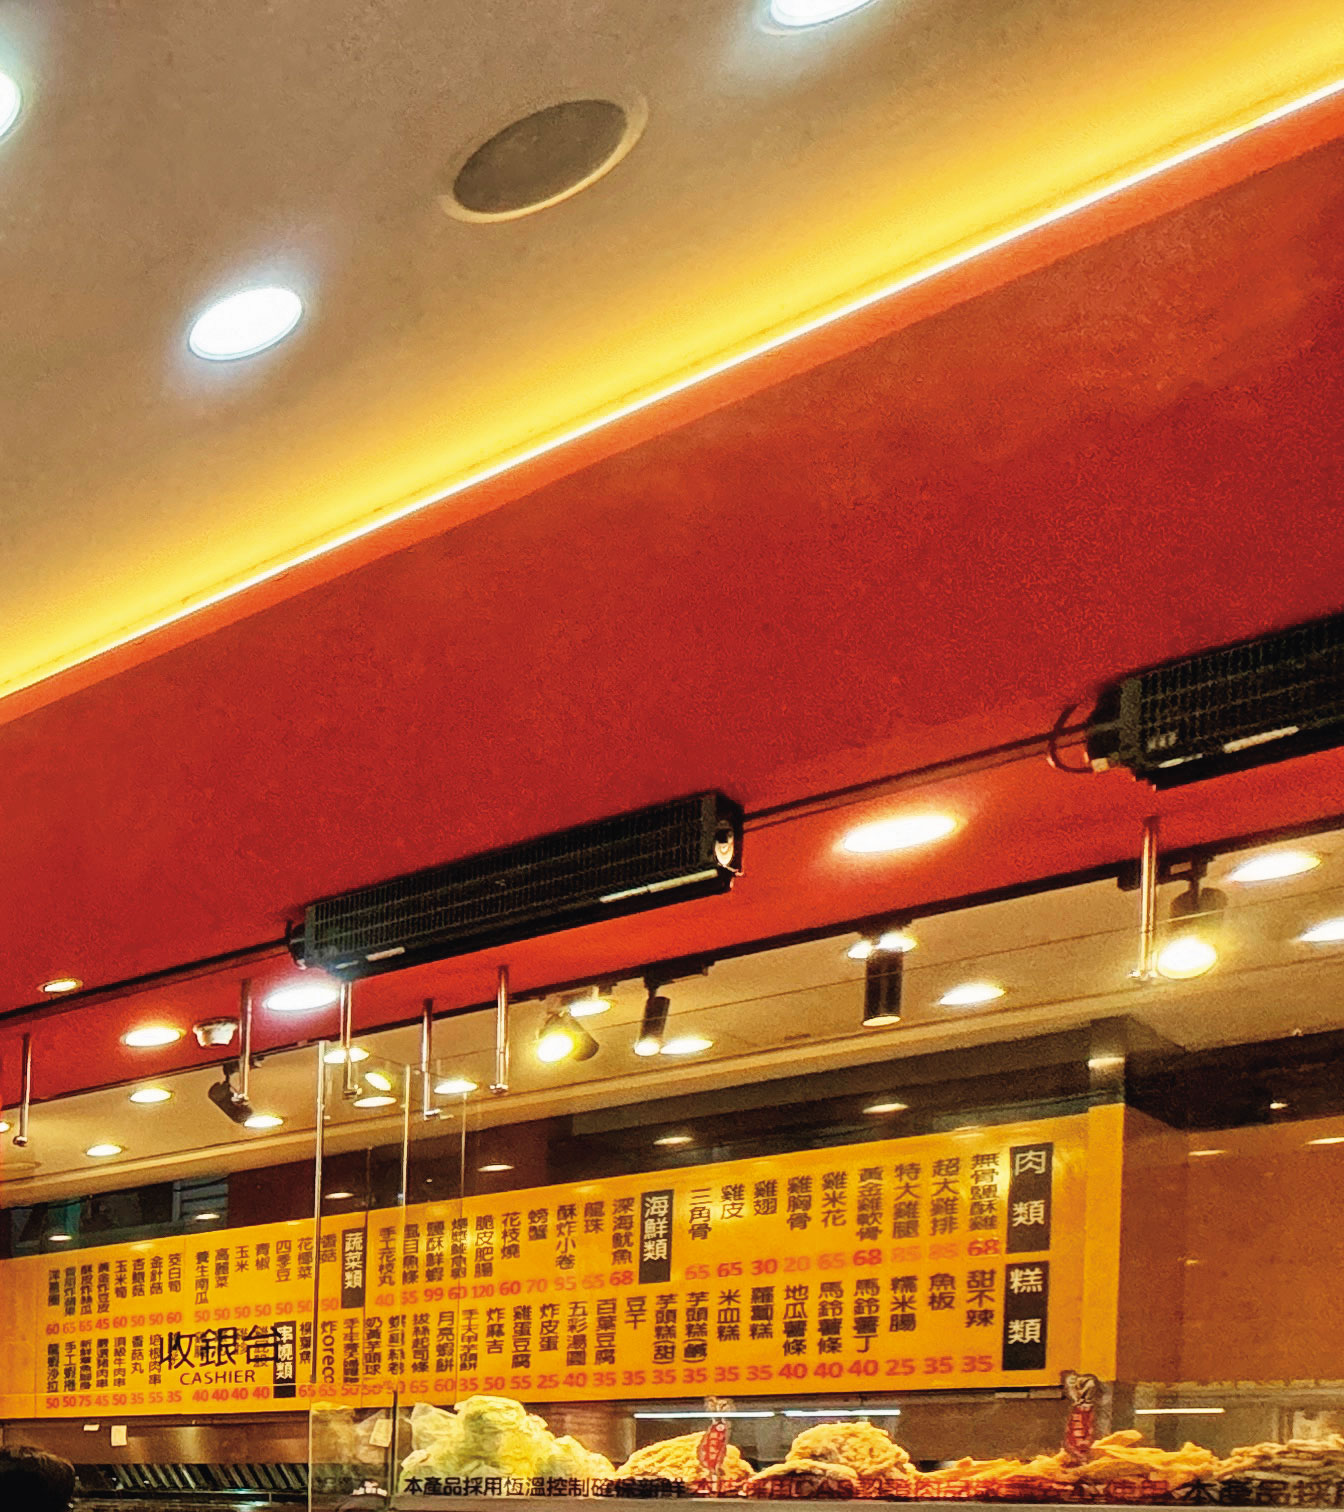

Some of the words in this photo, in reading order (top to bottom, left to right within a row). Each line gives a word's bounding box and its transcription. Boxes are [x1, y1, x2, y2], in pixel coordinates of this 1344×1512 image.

[753, 1179, 778, 1216] 雞翅
[929, 1157, 960, 1236] 超大雞排
[1012, 1150, 1047, 1227] 肉類
[720, 1183, 745, 1220] 雞皮
[786, 1175, 813, 1231] 雞胸骨
[821, 1171, 847, 1228] 雞米花
[856, 1166, 884, 1241] 黃金雞軟骨
[892, 1162, 921, 1239] 特大雞腿
[688, 1187, 712, 1241] 三角骨
[611, 1197, 636, 1266] 深海魷魚
[643, 1195, 669, 1262] 海鮮類
[967, 1239, 1000, 1256] 68
[234, 1245, 250, 1273] 玉米
[275, 1240, 292, 1283] 四季豆
[344, 1232, 364, 1290] 蔬菜類
[783, 1255, 811, 1273] 20
[853, 1248, 882, 1266] 68
[684, 1264, 711, 1280] 65
[716, 1262, 743, 1278] 65
[751, 1258, 778, 1275] 30
[526, 1278, 548, 1294] 70
[609, 1270, 633, 1286] 68
[424, 1287, 444, 1302] 99
[471, 1284, 495, 1299] 120
[499, 1280, 522, 1296] 60
[928, 1272, 956, 1311] 魚板
[889, 1275, 918, 1332] 糯米腸
[965, 1268, 996, 1328] 甜不辣
[1008, 1267, 1043, 1344] 糕類
[275, 1302, 294, 1315] 50
[624, 1296, 647, 1330] 豆干
[717, 1289, 741, 1342] 米血糕
[817, 1281, 843, 1354] 馬鈴薯條
[853, 1278, 880, 1353] 馬鈴薯丁
[539, 1303, 560, 1352] 炸皮蛋
[783, 1283, 809, 1356] 地瓜薯條
[486, 1307, 506, 1354] 炸麻吉
[511, 1305, 532, 1369] 雞蛋豆腐
[160, 1325, 282, 1370] 收銀台
[435, 1311, 455, 1373] 月亮蝦餅
[746, 1365, 773, 1381] 35
[778, 1363, 808, 1379] 40
[814, 1362, 843, 1378] 40
[848, 1359, 879, 1377] 40
[885, 1358, 915, 1376] 25
[923, 1356, 953, 1374] 35
[962, 1355, 994, 1373] 35
[180, 1370, 255, 1385] CASHIER
[482, 1376, 505, 1391] 50
[510, 1375, 532, 1390] 55
[537, 1374, 560, 1389] 25
[563, 1373, 587, 1388] 40
[592, 1371, 617, 1387] 35
[621, 1370, 646, 1386] 35
[652, 1369, 677, 1384] 35
[682, 1367, 708, 1384] 35
[714, 1366, 740, 1383] 35
[434, 1378, 456, 1392] 60
[459, 1378, 479, 1392] 35
